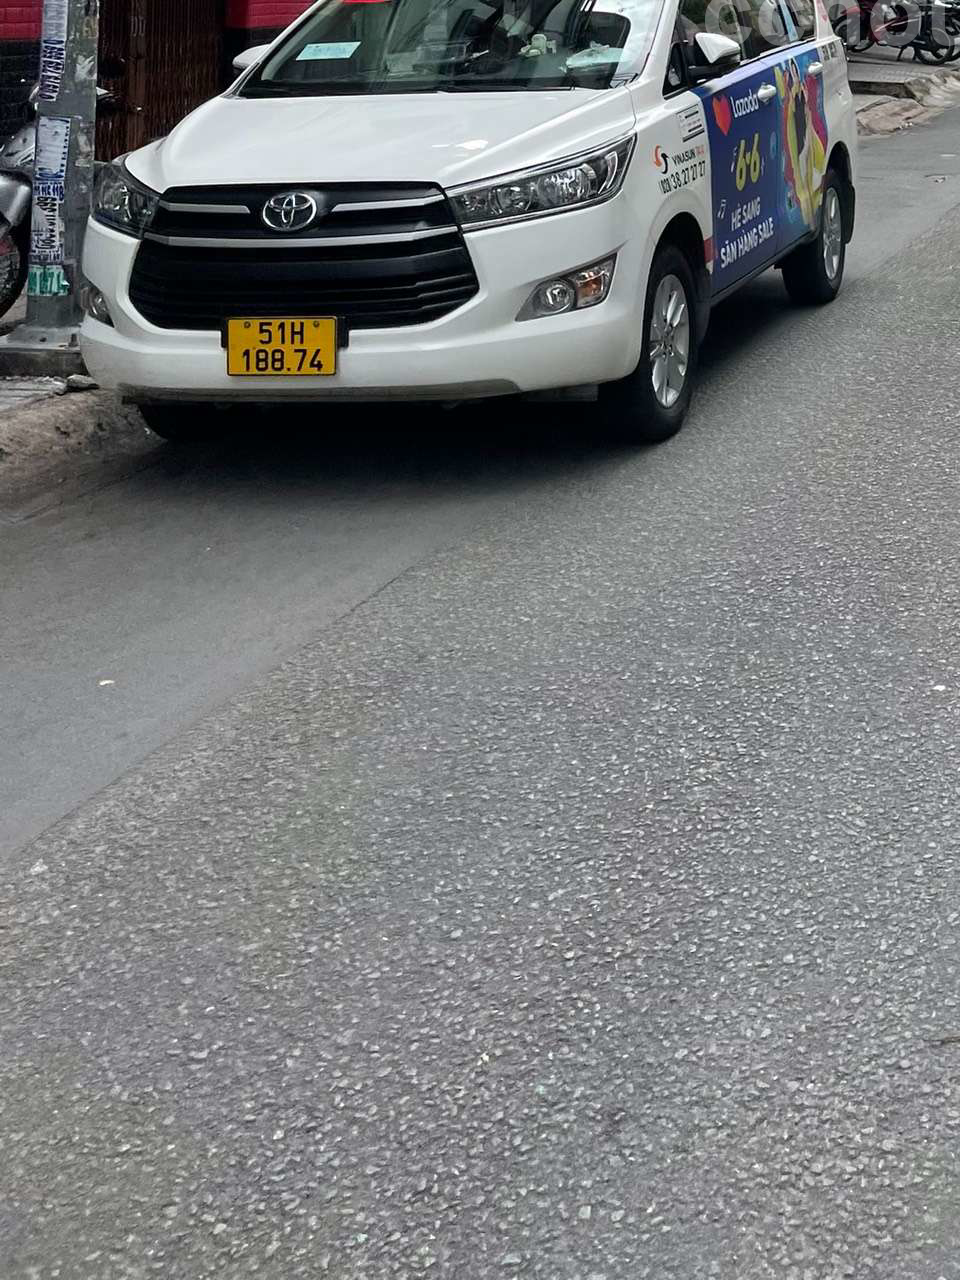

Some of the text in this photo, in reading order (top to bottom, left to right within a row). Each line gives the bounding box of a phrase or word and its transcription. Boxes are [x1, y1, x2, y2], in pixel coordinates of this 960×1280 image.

[730, 88, 759, 118] Lazada
[758, 217, 774, 244] SALE
[258, 321, 304, 345] 51H
[242, 349, 323, 371] 188.74
